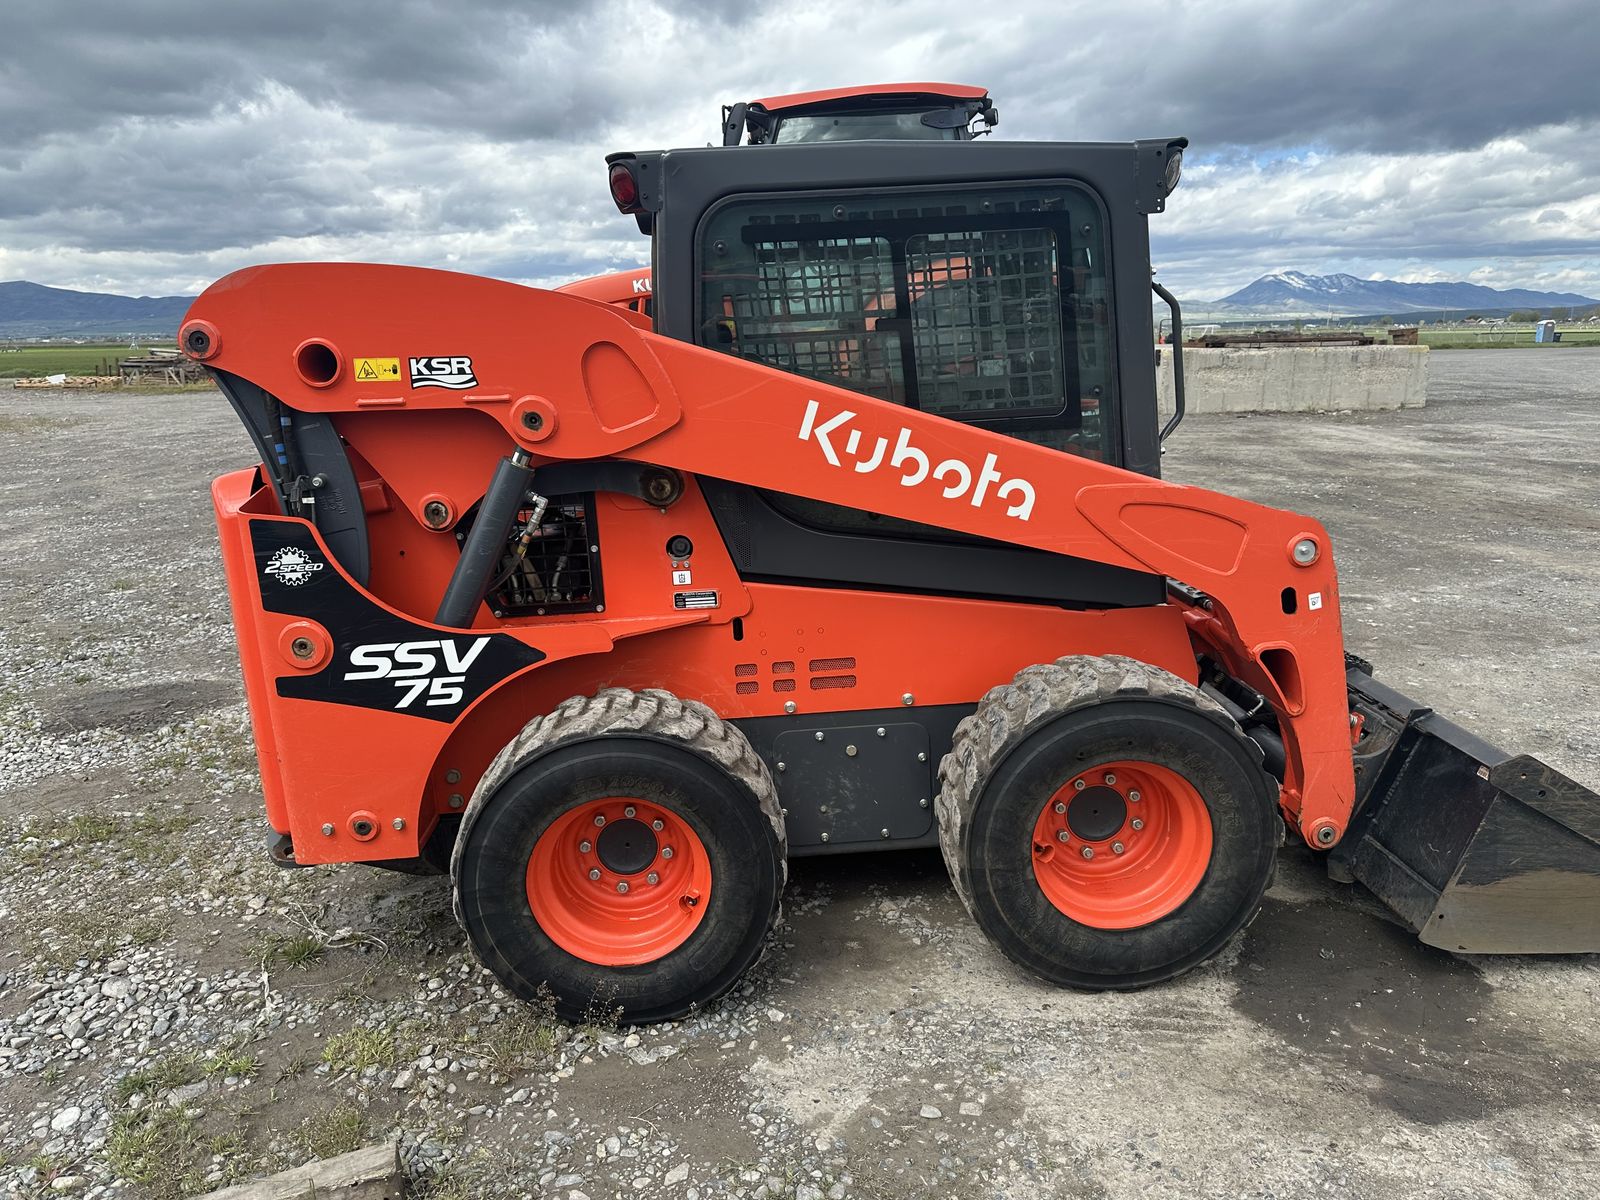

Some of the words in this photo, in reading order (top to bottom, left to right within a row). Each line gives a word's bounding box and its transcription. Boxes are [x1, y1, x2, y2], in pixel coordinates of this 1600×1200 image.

[410, 358, 472, 375] KSR
[798, 400, 1036, 521] Kubota
[343, 636, 491, 681] SSV
[394, 676, 466, 709] 75
